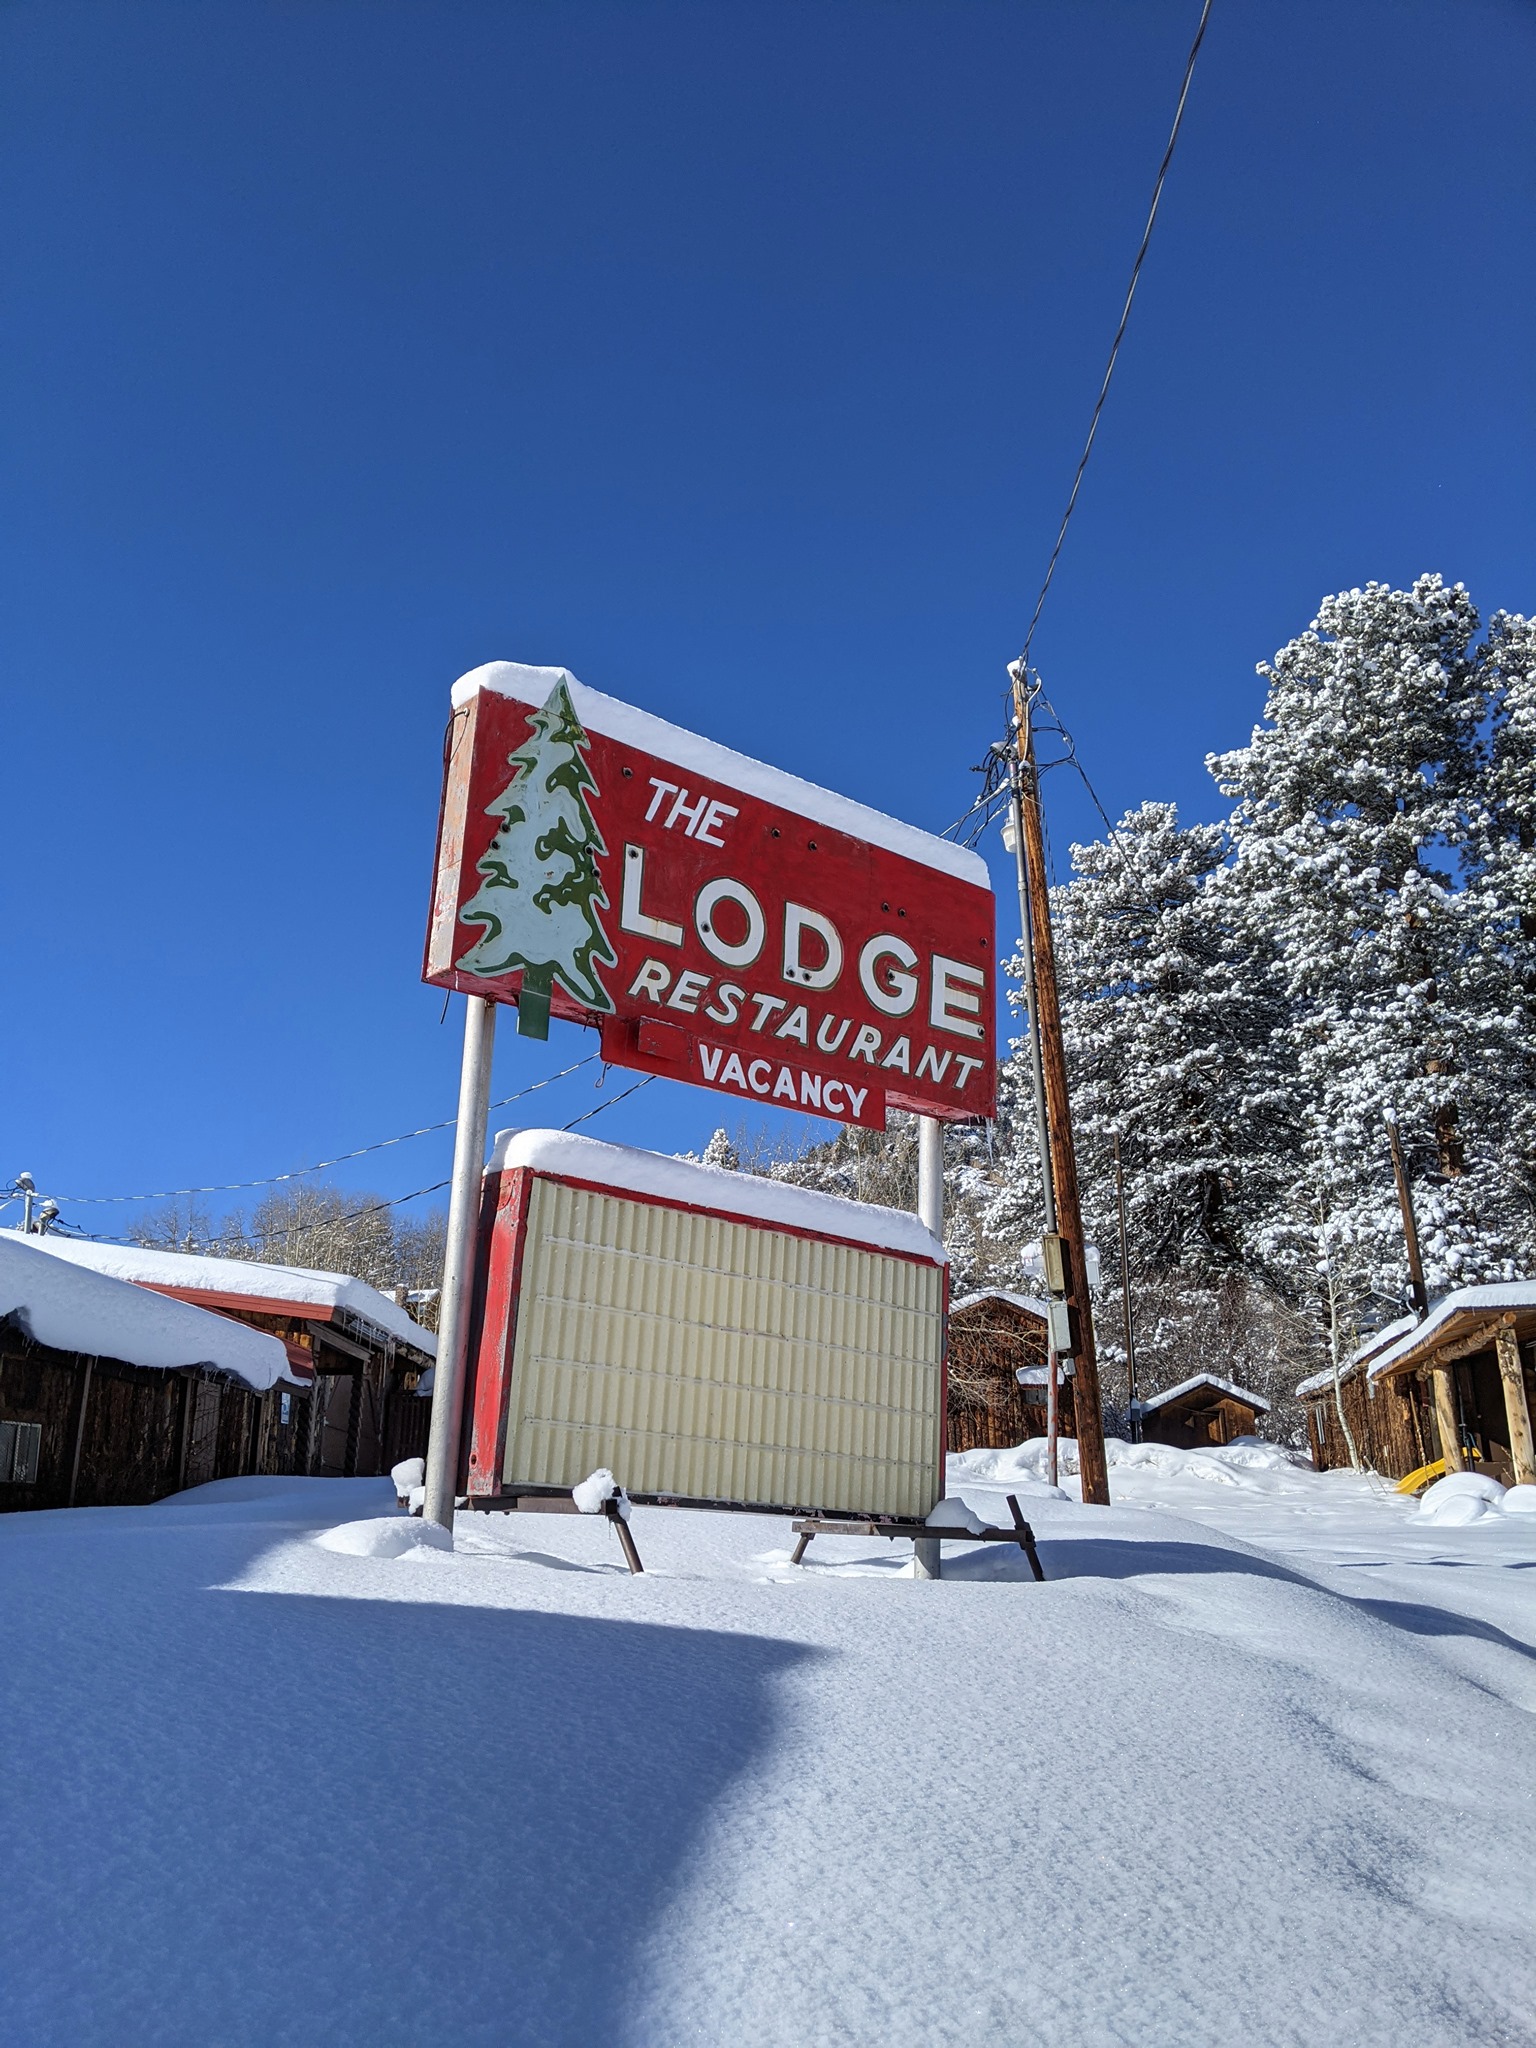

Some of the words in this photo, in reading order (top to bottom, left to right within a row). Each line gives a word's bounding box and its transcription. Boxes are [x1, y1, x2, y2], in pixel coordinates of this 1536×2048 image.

[645, 778, 738, 847] THE
[620, 843, 985, 1040] LODGE
[628, 958, 983, 1089] RESTAURANT
[699, 1045, 868, 1117] VACANCY
